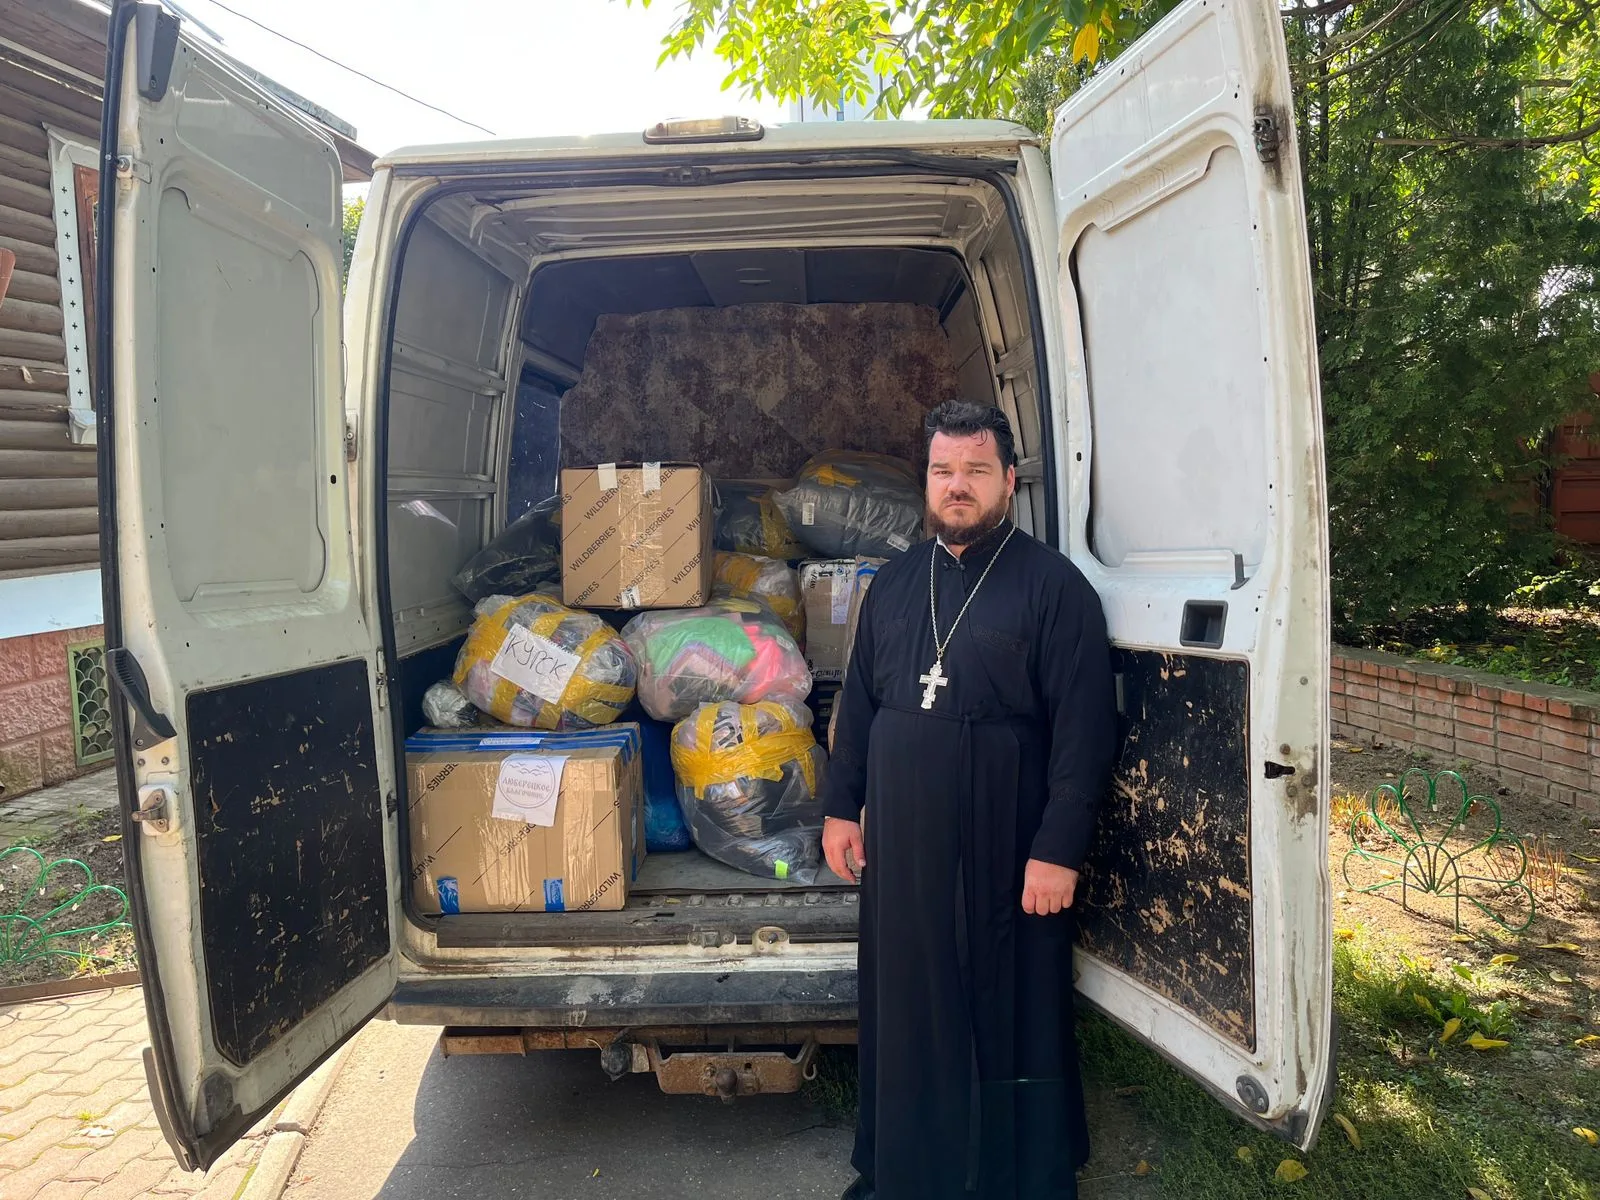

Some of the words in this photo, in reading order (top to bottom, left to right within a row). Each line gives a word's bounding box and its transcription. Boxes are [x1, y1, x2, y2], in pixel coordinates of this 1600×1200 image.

[569, 525, 617, 571] WILDBERRIES
[627, 506, 675, 553] WILDBERRIES
[505, 634, 567, 681] КУРСК
